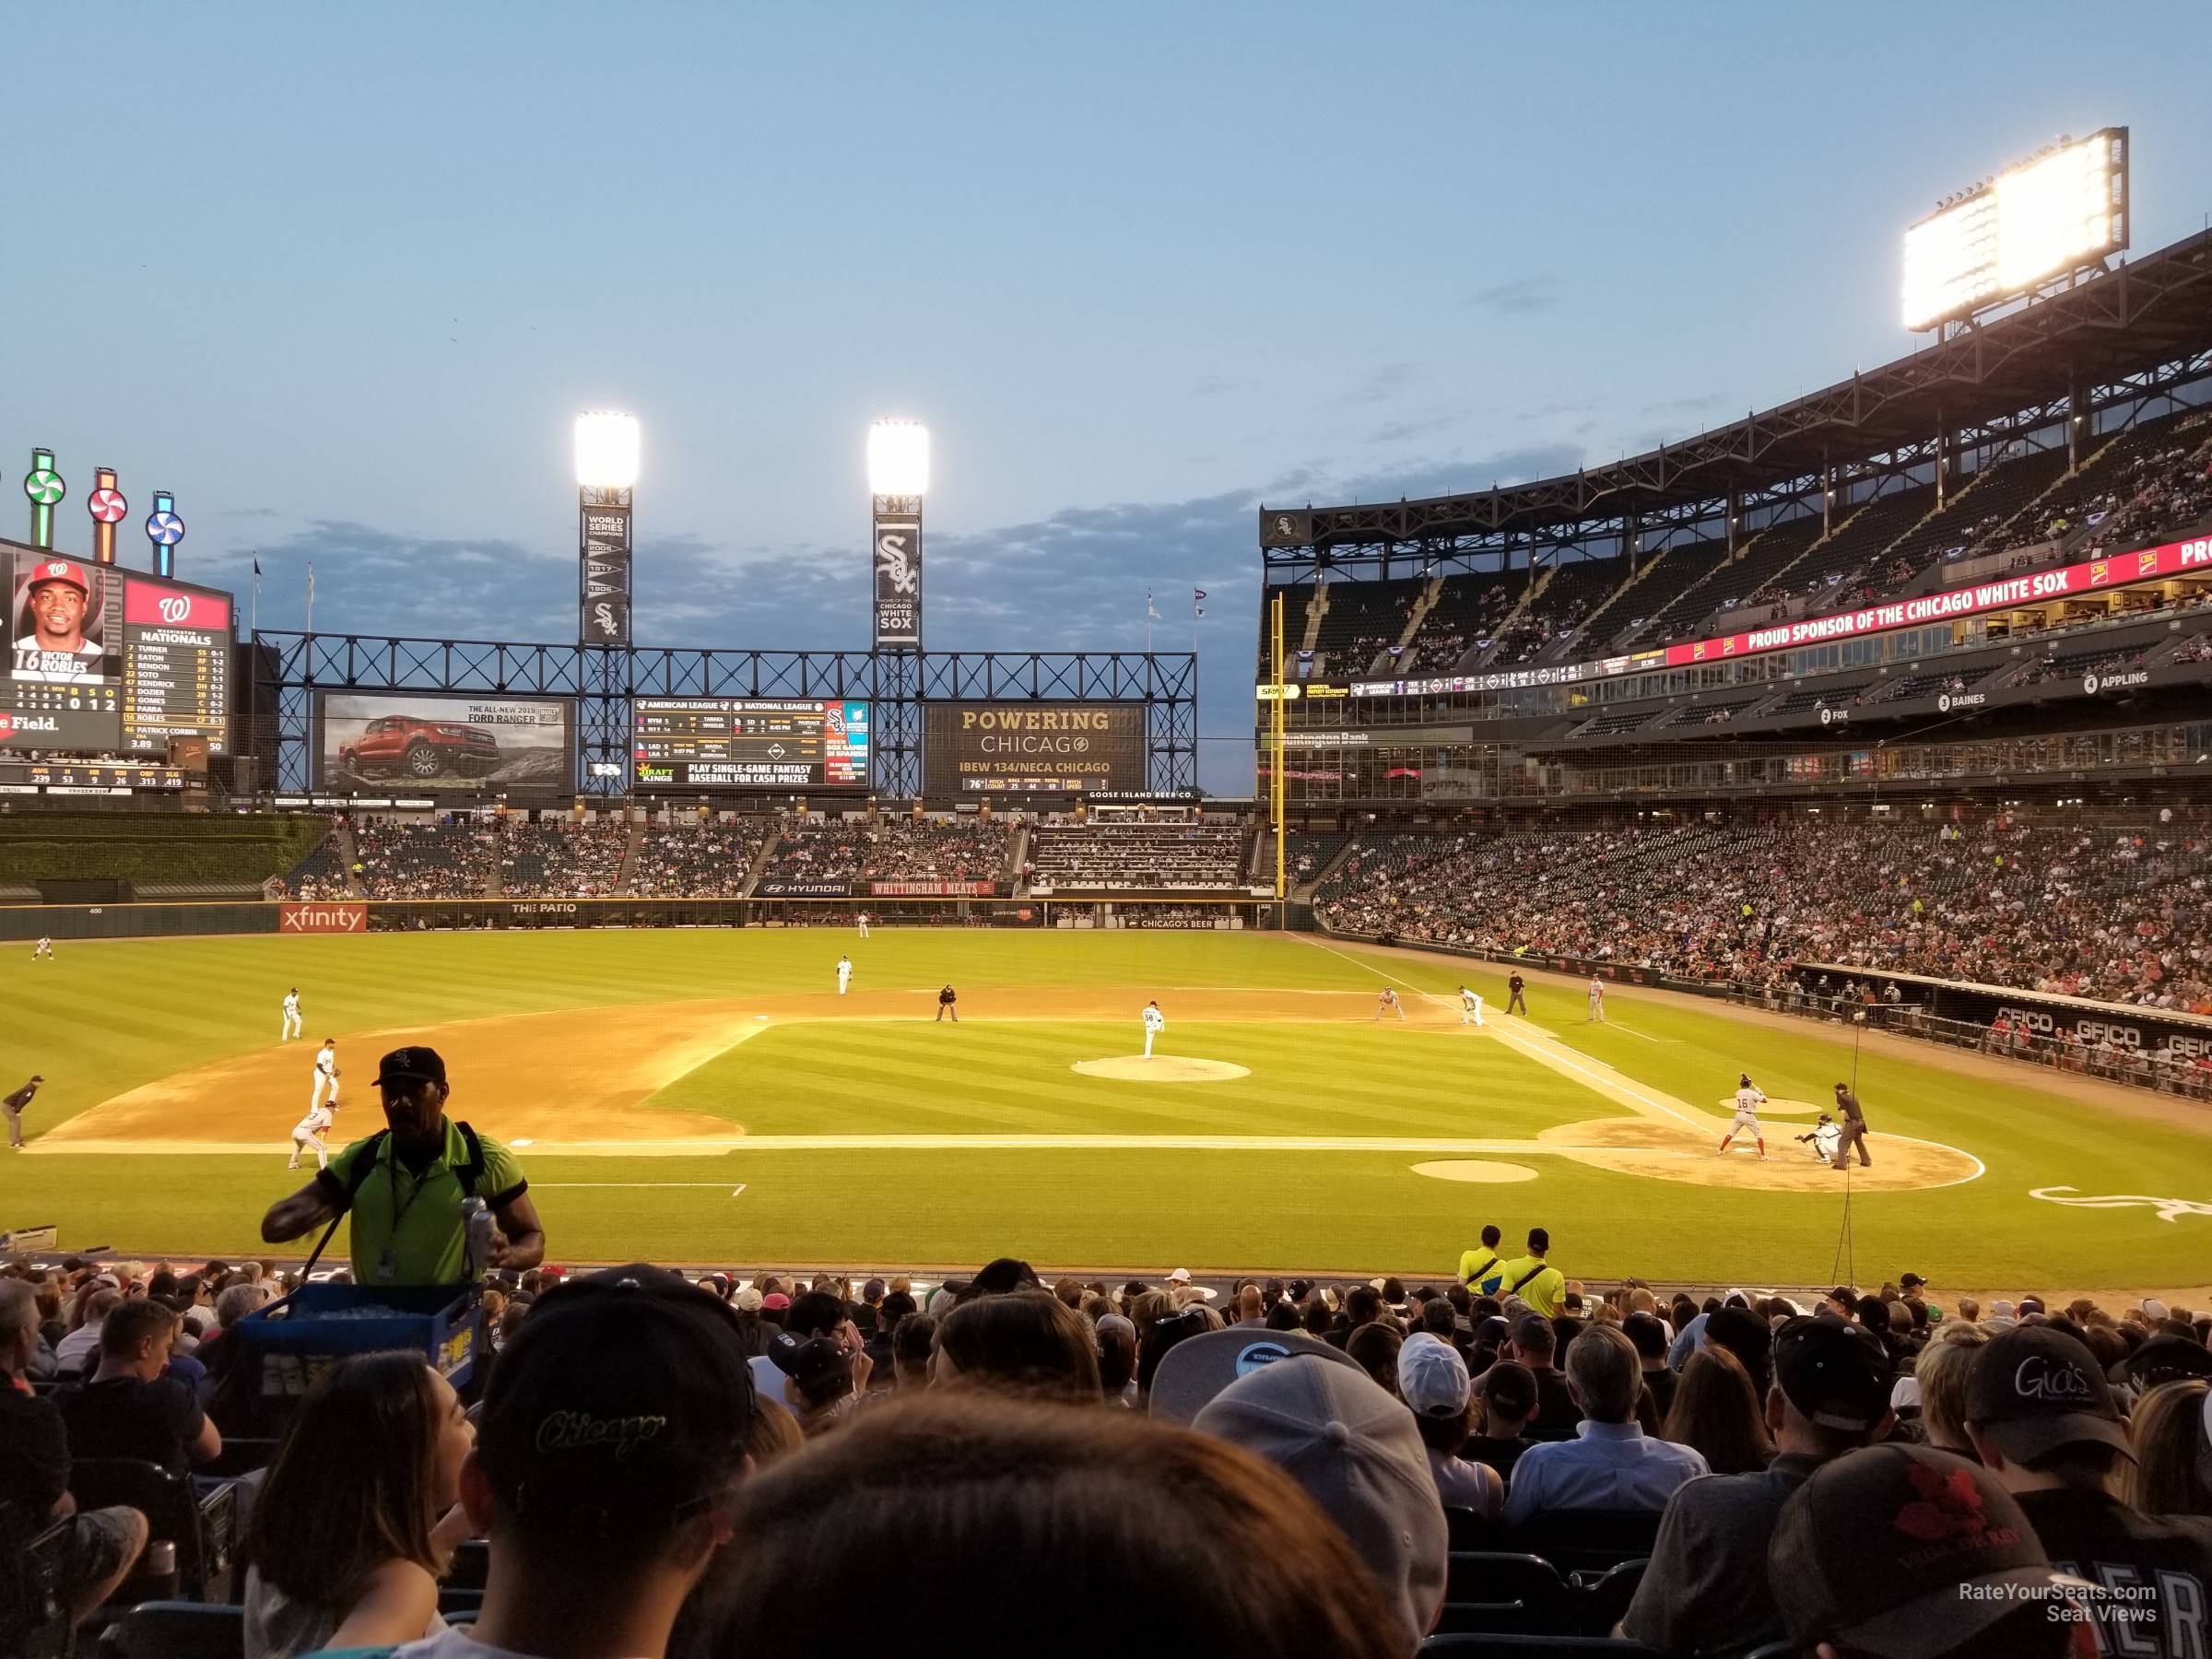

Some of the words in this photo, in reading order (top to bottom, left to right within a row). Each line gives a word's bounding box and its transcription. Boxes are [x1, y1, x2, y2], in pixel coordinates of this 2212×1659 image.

[1748, 629, 1790, 650] PROUD
[1793, 616, 1853, 641] SPONSOR
[1856, 609, 1875, 629] OF
[1876, 604, 1904, 626] THE
[1906, 590, 1973, 620] CHICAGO
[1976, 579, 2029, 607] WHITE
[2033, 571, 2068, 595] SOX
[880, 617, 912, 629] SOX
[141, 632, 211, 645] NATIONALS
[16, 650, 40, 671] 16
[41, 651, 73, 661] VICTOR
[40, 660, 88, 673] ROBLES
[2088, 679, 2094, 688] 4
[2101, 672, 2148, 688] APPLING
[70, 698, 81, 709] 0
[89, 700, 98, 710] 1
[106, 700, 115, 711] 2
[1952, 694, 1985, 706] BAINES
[469, 714, 494, 723] FORD
[497, 715, 535, 724] RANGER
[1833, 710, 1848, 719] FOX
[11, 717, 59, 730] Field.
[963, 712, 1109, 730] POWERING
[1341, 733, 1369, 744] Bank
[688, 764, 710, 773] PLAY
[712, 765, 771, 773] SINGLE-GAME
[773, 765, 812, 774] FANTASY
[959, 762, 991, 773] IBEW
[994, 762, 1052, 773] 134/NECA
[1055, 763, 1110, 773] CHICAGO
[688, 774, 733, 782] BASEBALL
[735, 774, 752, 782] FOR
[754, 774, 776, 782] CASH
[779, 775, 809, 783] PRIZES
[875, 883, 942, 894] WHITTINGHAM
[946, 883, 977, 894] MEATS
[512, 904, 536, 913] THE
[540, 904, 577, 913] PATIO
[285, 906, 362, 931] xfinity
[2077, 1020, 2141, 1048] GEICO
[1737, 1099, 1748, 1109] 16
[2016, 1356, 2090, 1399] Gia's
